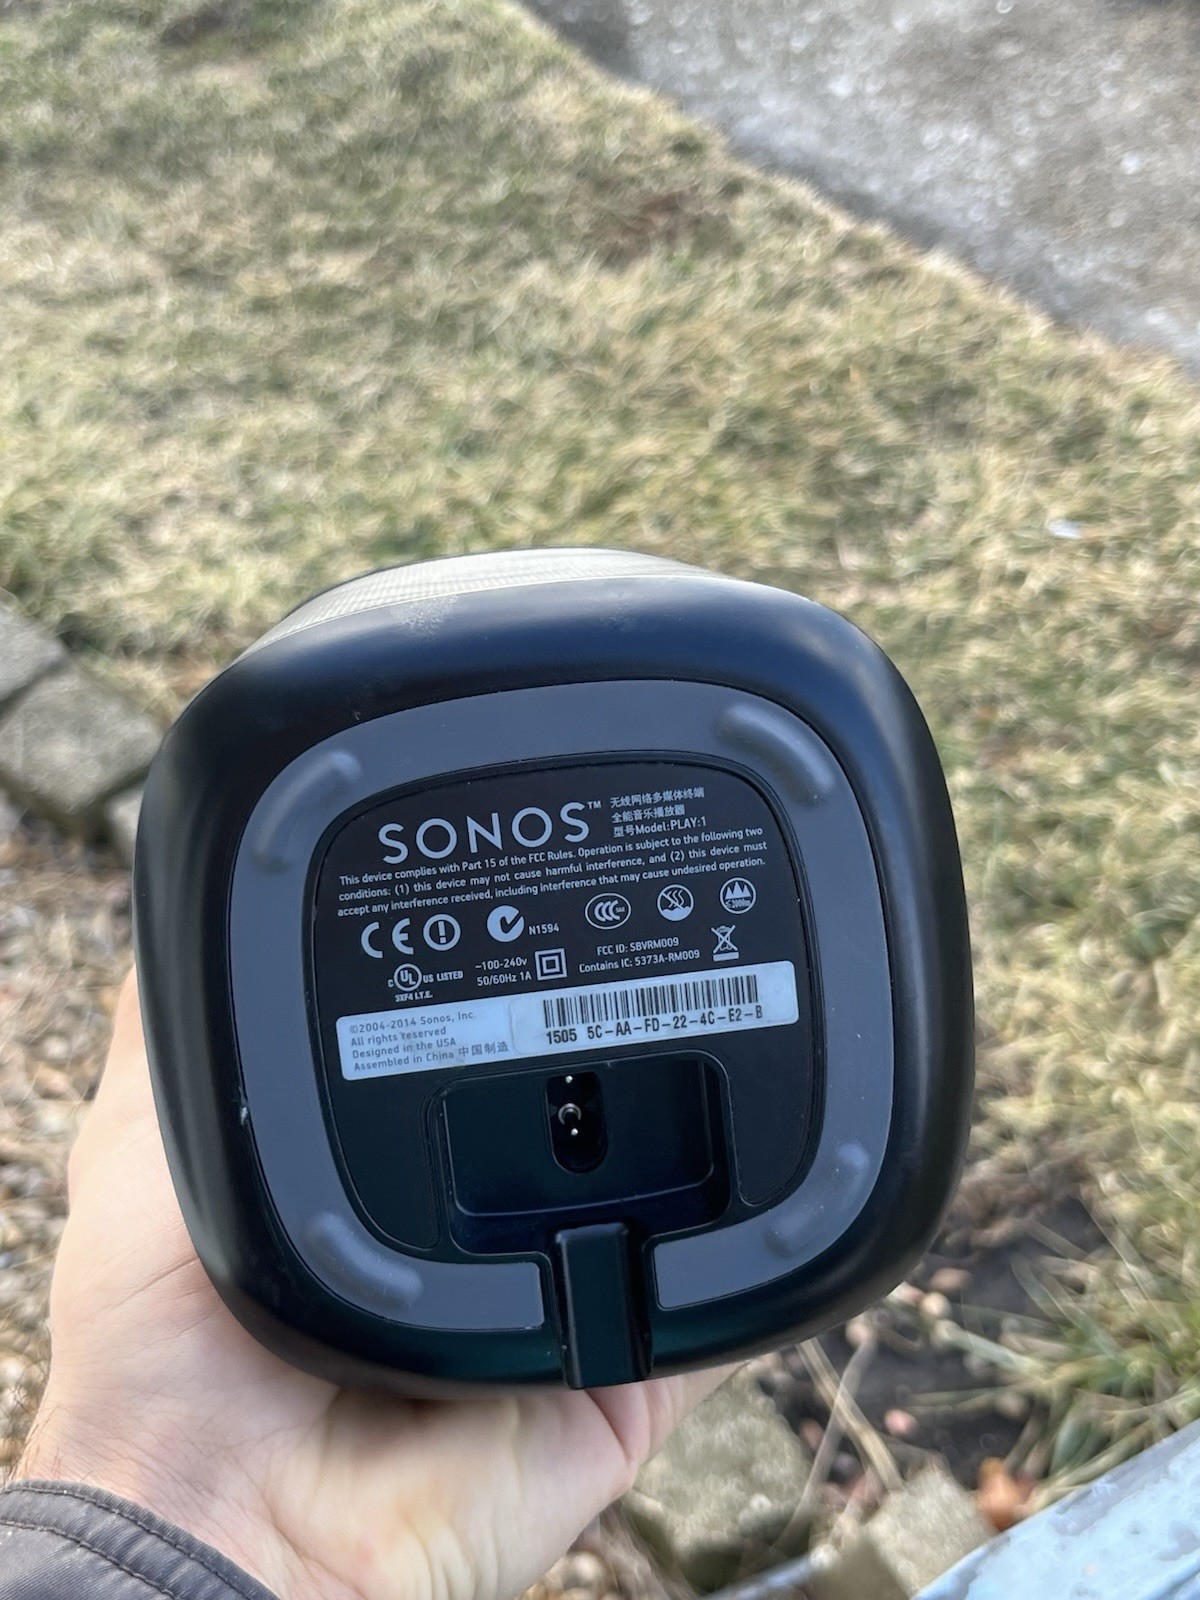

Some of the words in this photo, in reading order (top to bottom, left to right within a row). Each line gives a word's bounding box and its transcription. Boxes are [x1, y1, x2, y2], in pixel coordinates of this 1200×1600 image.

[611, 803, 685, 823] 全能音乐播放器
[339, 875, 360, 885] This
[361, 871, 392, 883] device
[394, 866, 437, 879] complies
[438, 862, 460, 873] with
[461, 860, 482, 871] Part
[484, 857, 496, 868] 15
[498, 855, 508, 866] of
[510, 855, 526, 865] the
[528, 851, 545, 863] FCC
[547, 849, 575, 861] Rules.
[577, 844, 623, 858] Operation
[625, 842, 633, 851] is
[635, 838, 669, 850] subject
[671, 837, 681, 846] to
[683, 834, 699, 844] the
[700, 829, 743, 842] following
[745, 827, 762, 836] two
[338, 887, 390, 901] conditions:
[394, 882, 409, 896] (1)
[413, 881, 432, 892] this
[435, 877, 466, 889] device
[469, 875, 490, 886] may
[494, 872, 510, 882] not
[514, 869, 541, 880] cause
[545, 862, 582, 876] harmful
[585, 857, 645, 871] interference,
[649, 852, 666, 863] and
[670, 849, 684, 862] (2)
[688, 848, 706, 858] this
[709, 844, 739, 856] device
[743, 841, 767, 851] must
[337, 904, 370, 916] accept
[371, 903, 389, 913] any
[390, 896, 448, 910] interference
[450, 888, 493, 903] received,
[494, 884, 538, 897] including
[539, 878, 596, 892] interference
[598, 874, 618, 884] that
[620, 873, 640, 882] may
[642, 869, 669, 879] cause
[671, 861, 717, 876] undesired
[718, 857, 765, 871] operation.
[528, 922, 559, 935] N1594
[596, 944, 613, 956] FCC
[615, 943, 628, 953] ID:
[629, 936, 679, 952] SBVRM009
[579, 960, 619, 973] Contains
[621, 957, 632, 967] IC:
[634, 948, 700, 966] 5373A-RM009
[436, 970, 463, 981] LISTED
[476, 972, 517, 986] 50/60Hz
[519, 970, 531, 981] 1A
[349, 1017, 416, 1034] ©2004-2014
[420, 1014, 454, 1025] Sonos,
[457, 1011, 475, 1021] Inc.
[351, 1036, 364, 1046] All
[367, 1033, 398, 1045] rights
[399, 1025, 446, 1040] reserved
[546, 1028, 577, 1044] 1505
[352, 1044, 399, 1059] Designed
[403, 1043, 412, 1052] in
[415, 1040, 432, 1050] the
[436, 1037, 456, 1048] USA
[354, 1055, 409, 1071] Assembled
[412, 1054, 422, 1063] in
[426, 1051, 454, 1061] China
[458, 1042, 508, 1057] 中国制造
